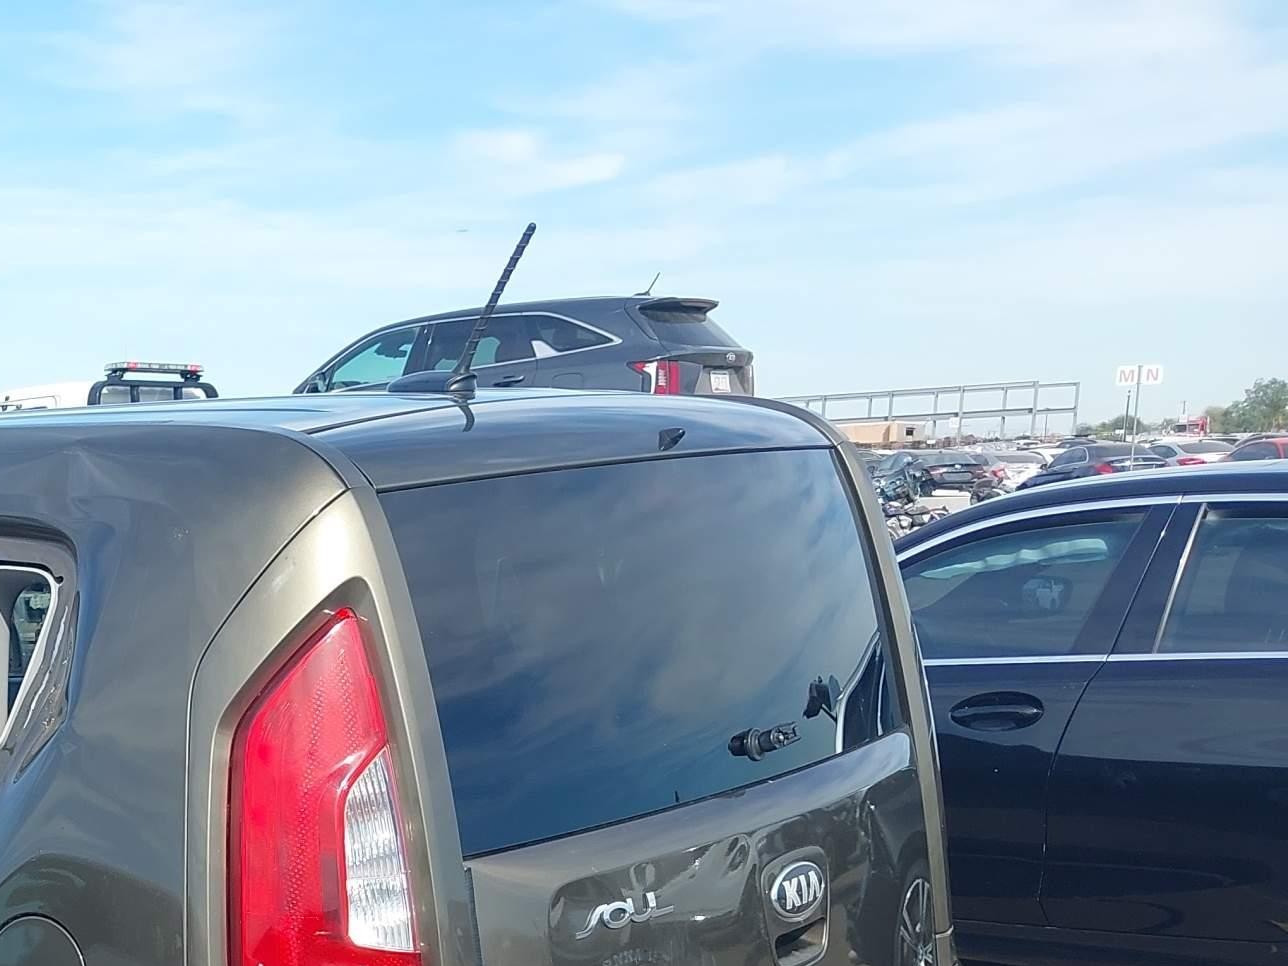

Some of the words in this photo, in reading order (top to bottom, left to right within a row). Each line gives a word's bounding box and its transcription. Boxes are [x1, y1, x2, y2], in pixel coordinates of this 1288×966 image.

[1119, 369, 1135, 383] M
[1146, 367, 1159, 382] N
[782, 870, 820, 910] KIA
